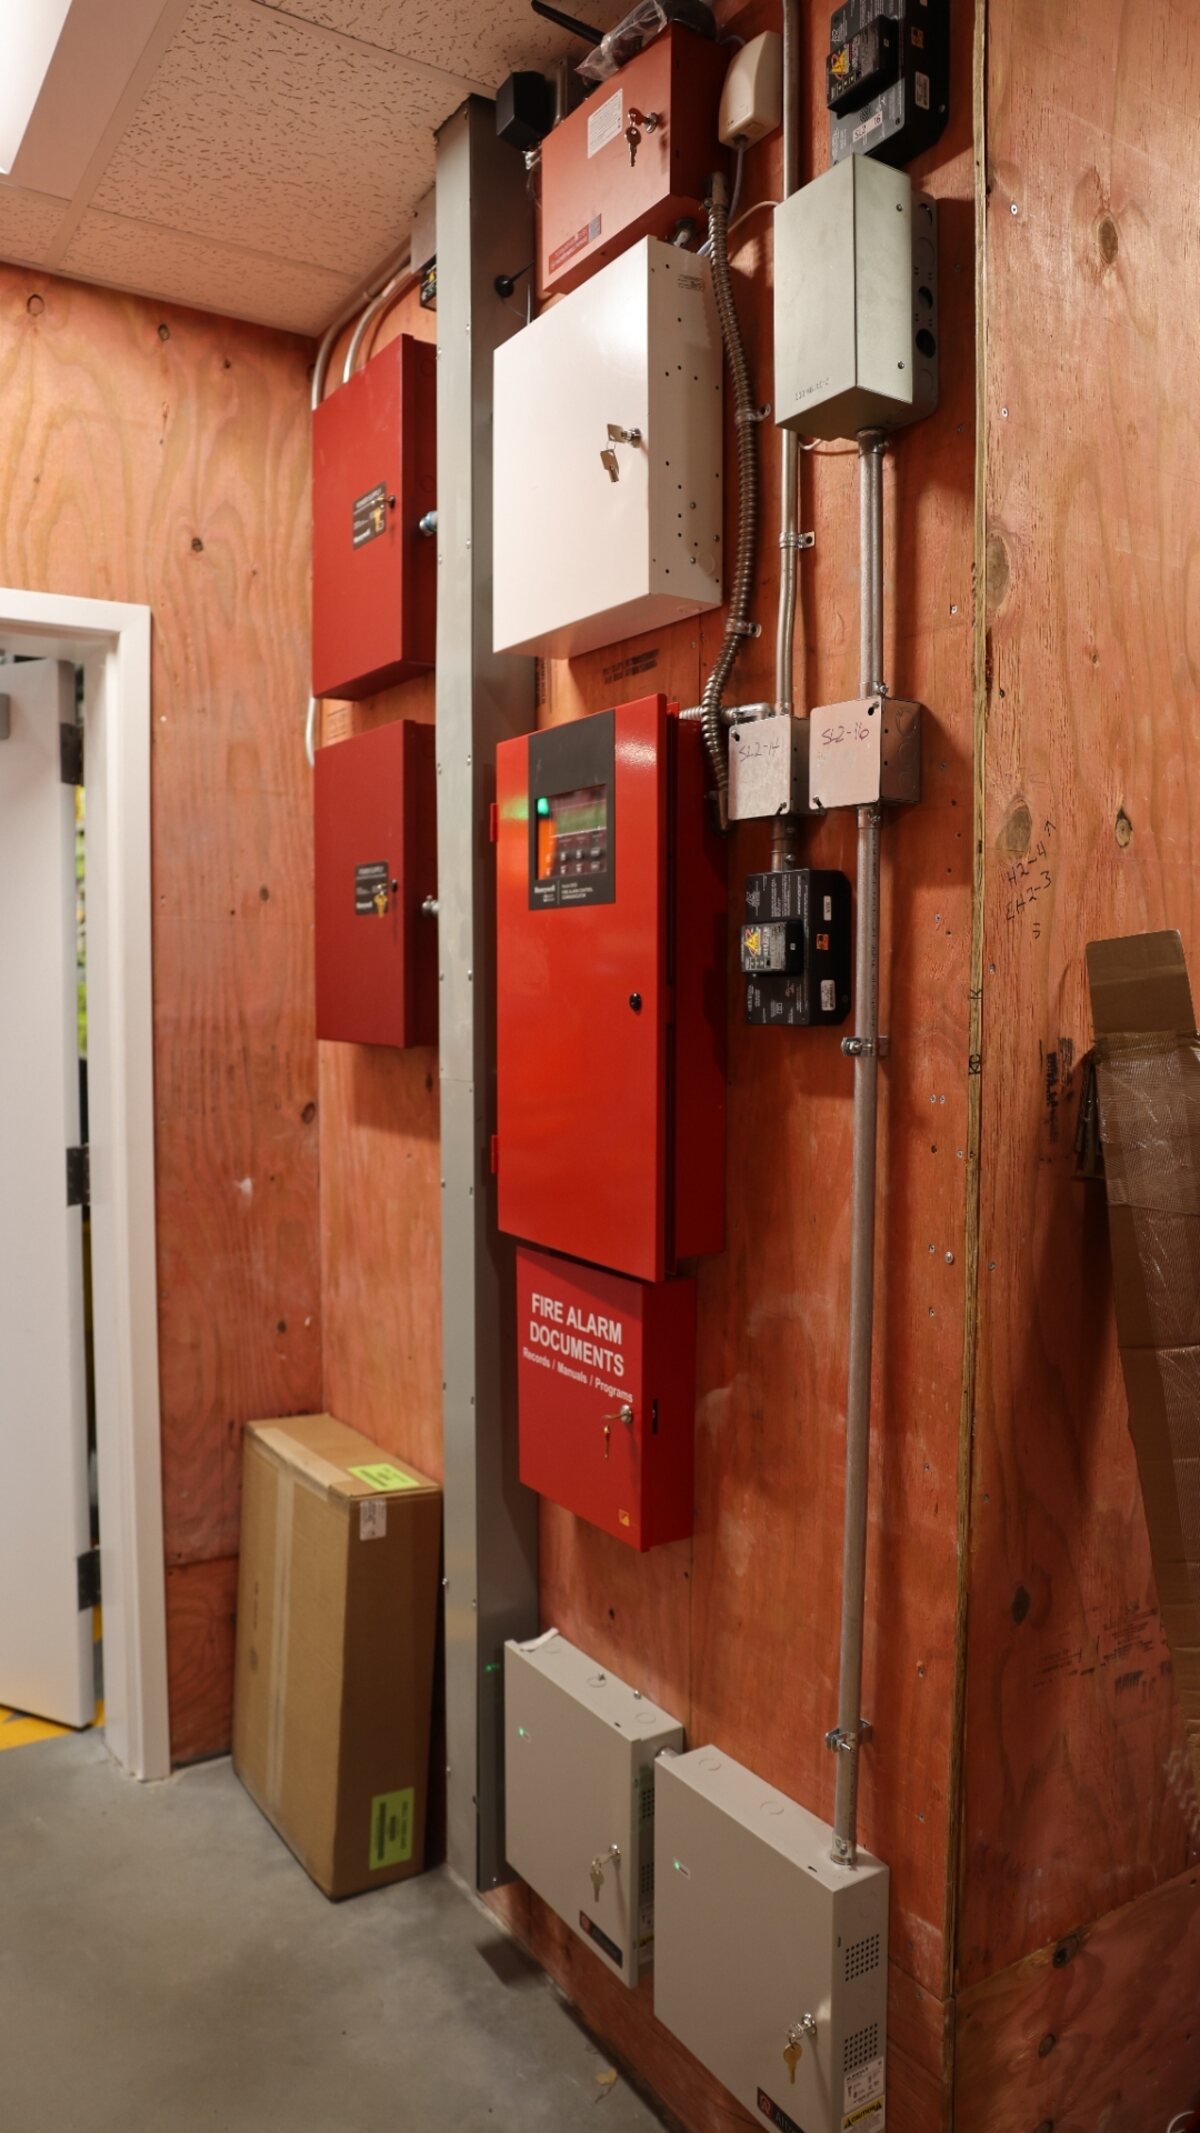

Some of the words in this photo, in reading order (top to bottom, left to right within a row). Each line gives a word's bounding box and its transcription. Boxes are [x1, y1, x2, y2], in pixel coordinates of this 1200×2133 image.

[821, 722, 870, 746] SL2-16
[532, 1292, 564, 1324] FIRE
[566, 1306, 622, 1345] ALARM
[523, 1346, 551, 1369] Records
[557, 1361, 588, 1384] Manuals
[595, 1377, 633, 1403] Programs
[530, 1321, 625, 1377] DOCUMENTS
